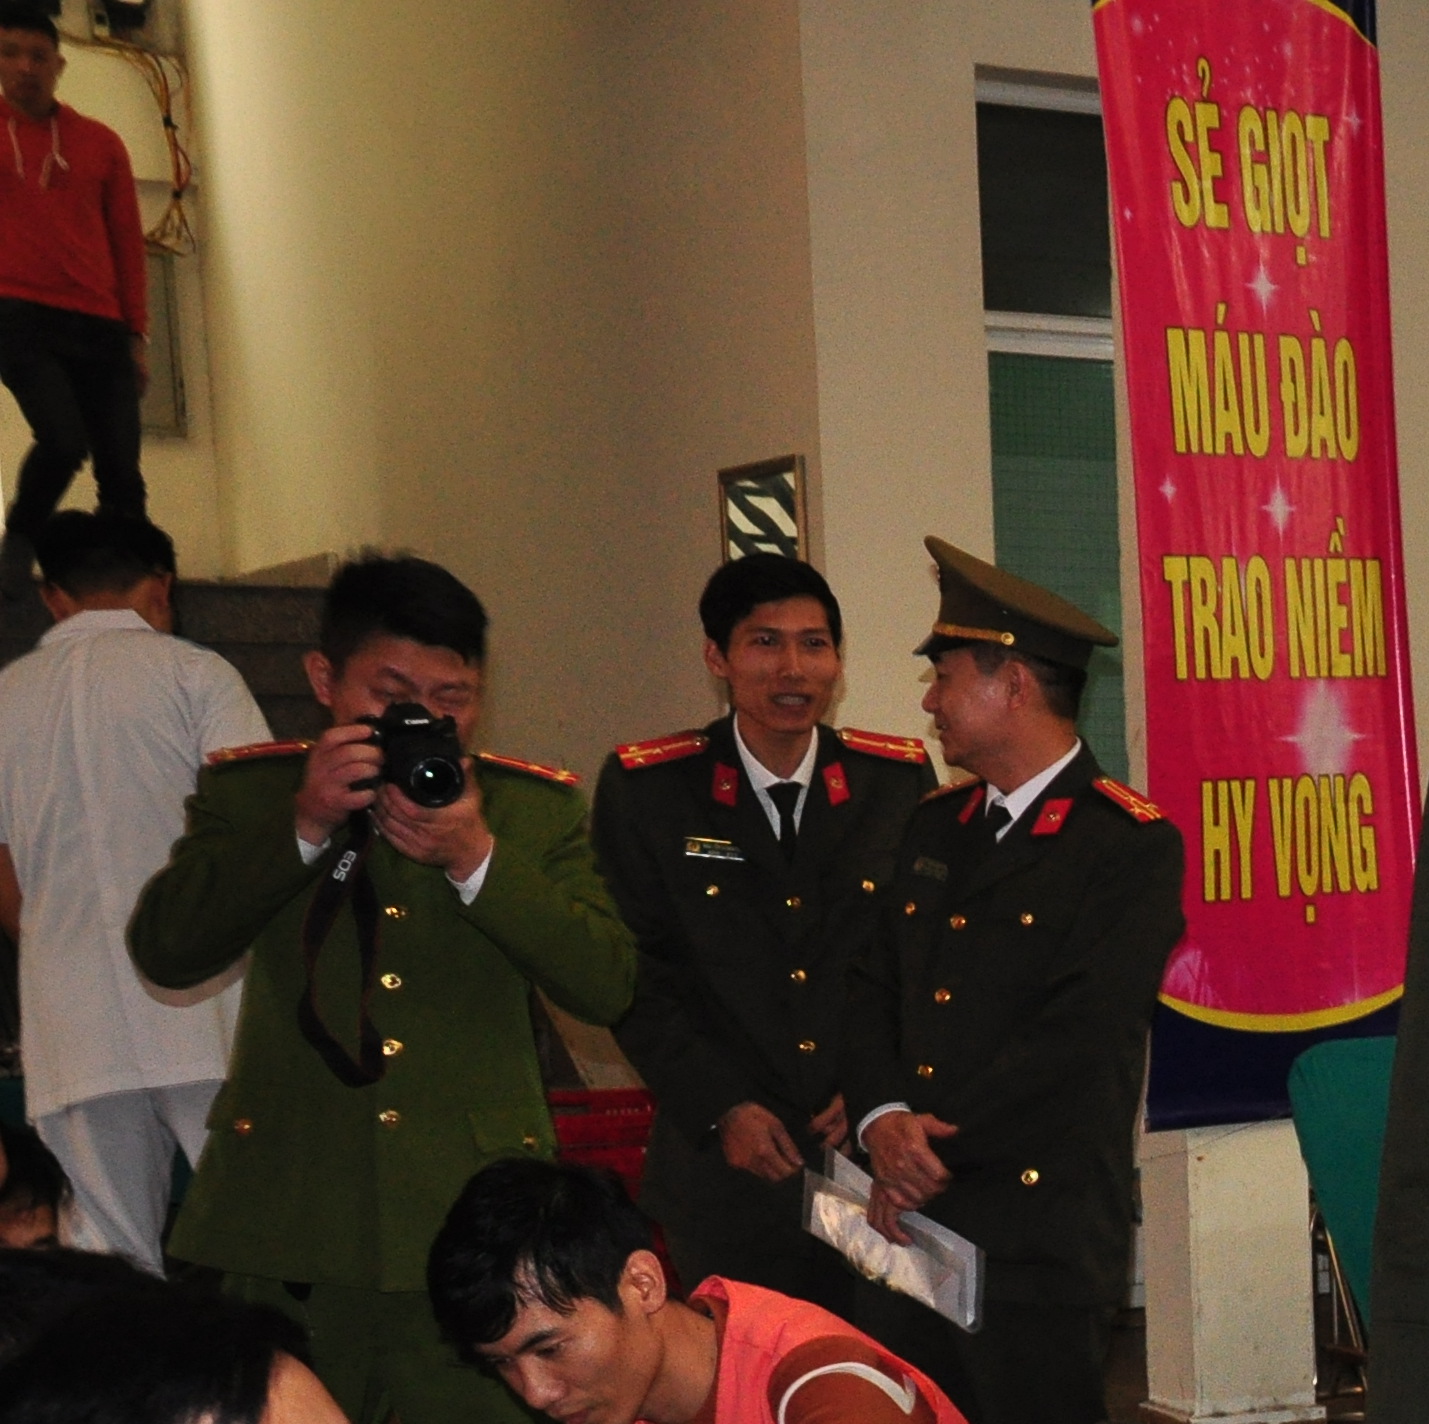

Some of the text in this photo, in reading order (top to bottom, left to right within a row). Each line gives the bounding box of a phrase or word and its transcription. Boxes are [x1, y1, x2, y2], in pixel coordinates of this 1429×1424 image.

[1166, 57, 1331, 267] SẺ GIỌT
[1165, 303, 1360, 463] MÁU ĐÀO
[1162, 516, 1387, 682] TRAO NIỀM
[332, 850, 357, 882] EOS
[1202, 771, 1377, 925] HY VỌNG
